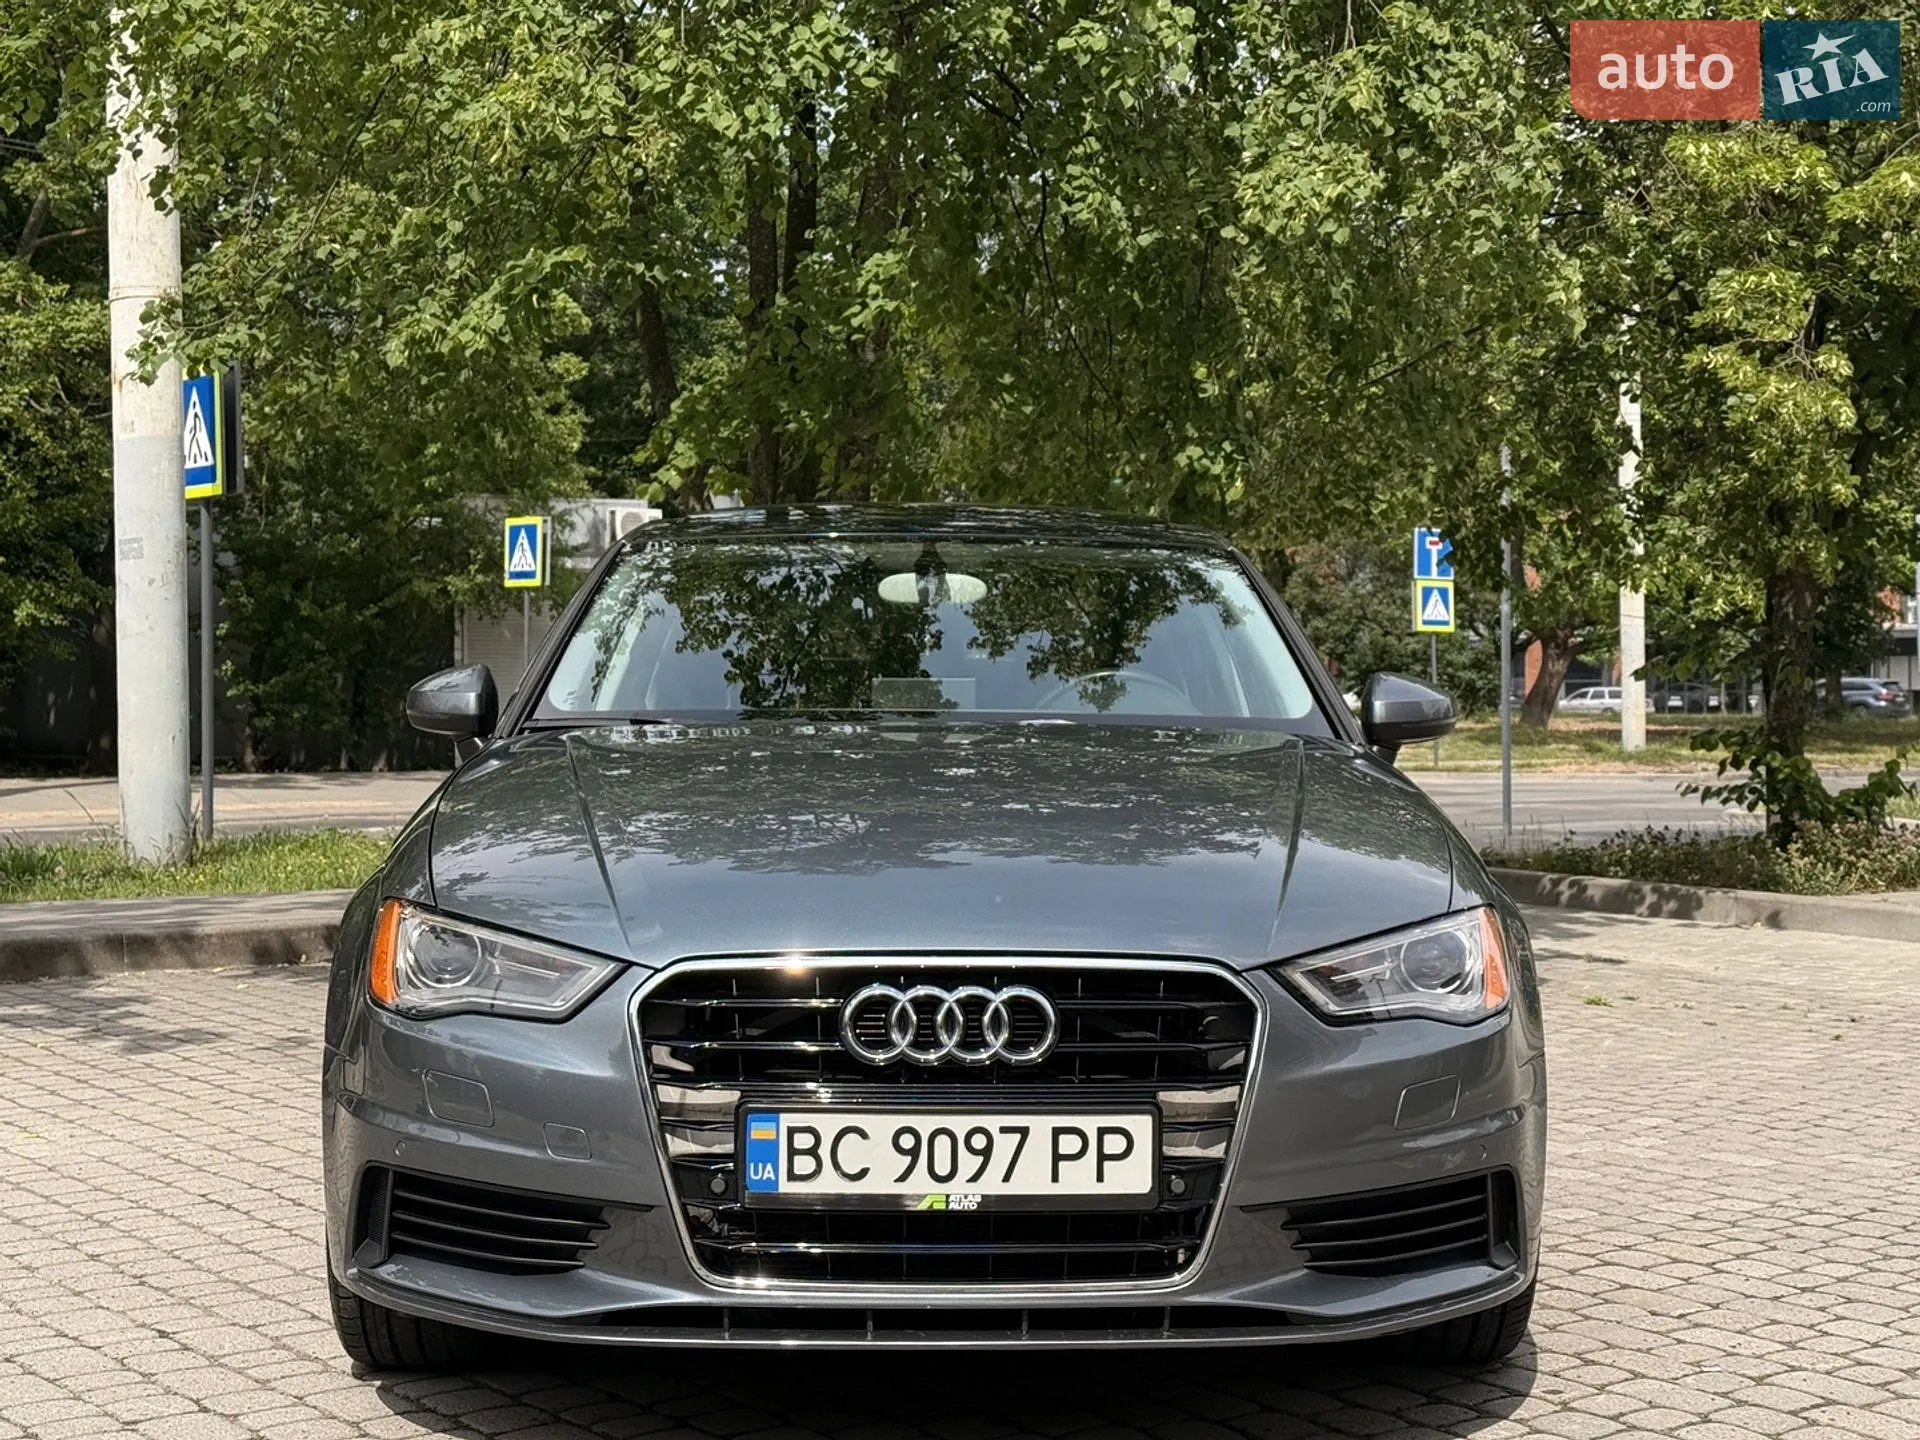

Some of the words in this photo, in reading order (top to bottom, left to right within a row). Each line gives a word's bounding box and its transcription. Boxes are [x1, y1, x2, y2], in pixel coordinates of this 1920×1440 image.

[787, 1126, 871, 1183] BC
[892, 1126, 1031, 1183] 9097
[1051, 1127, 1135, 1183] PP
[750, 1162, 776, 1181] UA
[948, 1202, 978, 1210] AUTO
